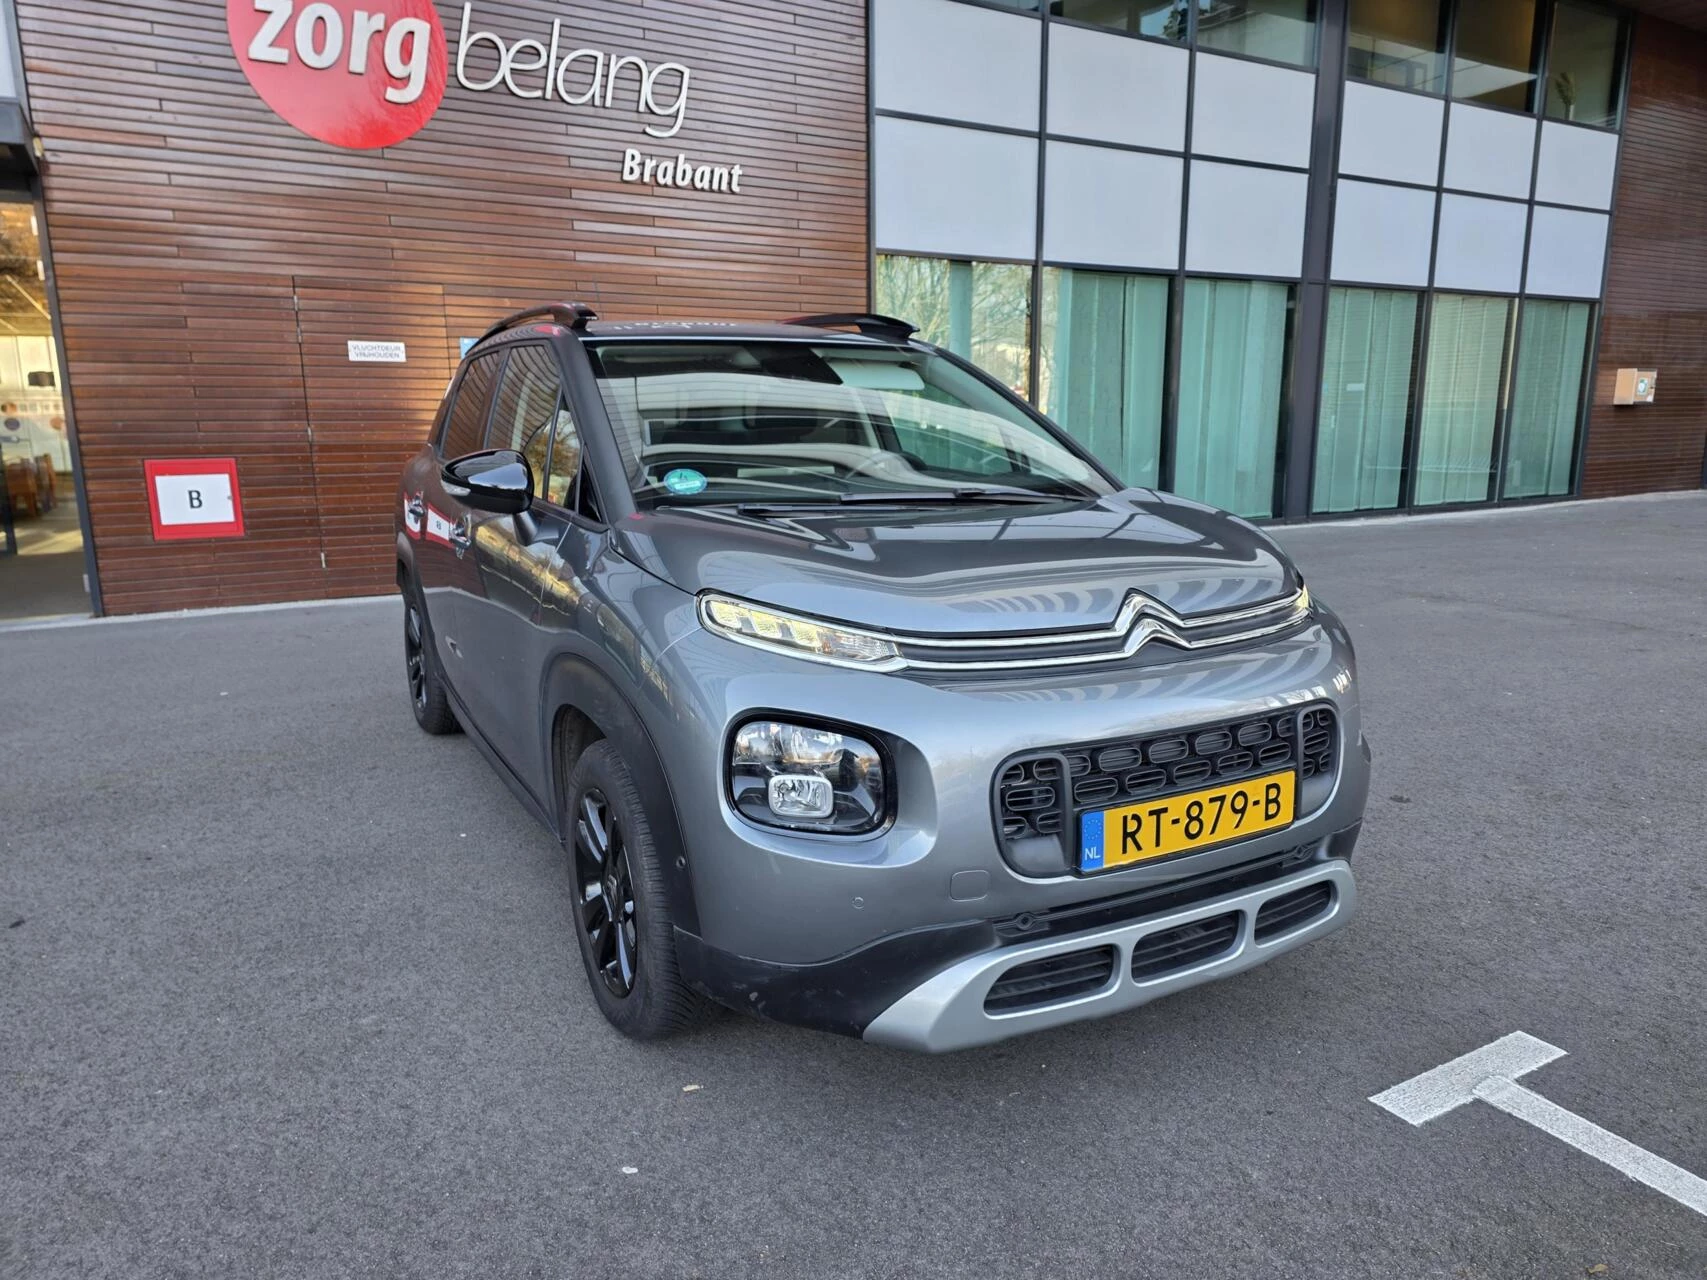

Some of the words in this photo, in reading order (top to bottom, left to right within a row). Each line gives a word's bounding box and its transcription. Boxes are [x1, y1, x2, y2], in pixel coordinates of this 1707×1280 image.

[248, 0, 431, 104] zorg
[456, 2, 690, 138] belang
[622, 148, 743, 193] Brabant
[188, 490, 203, 509] B
[1121, 783, 1281, 855] RT-879-B
[1084, 847, 1101, 861] NL
